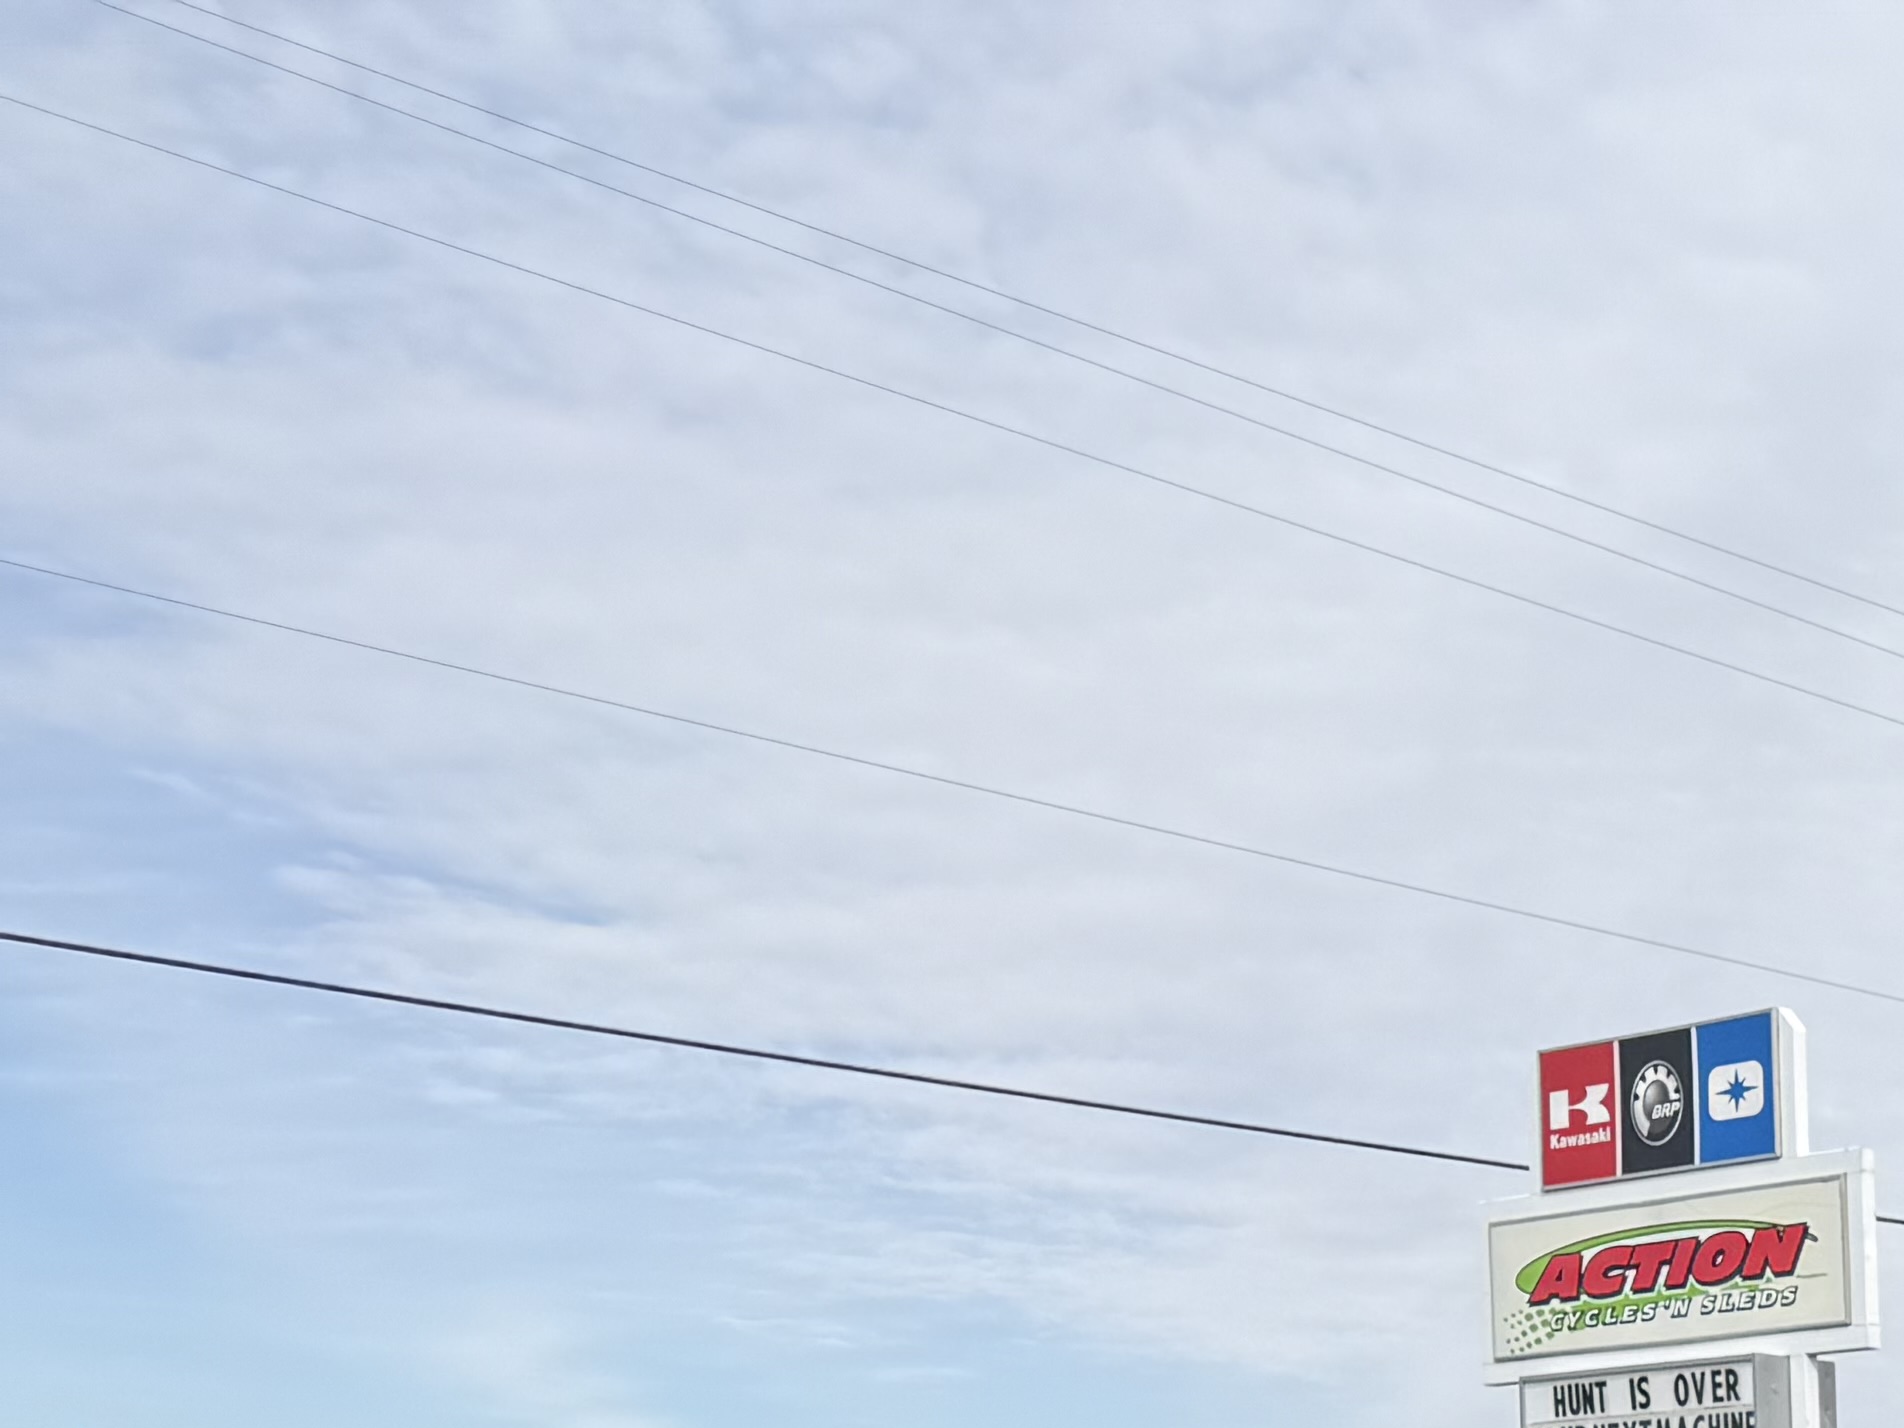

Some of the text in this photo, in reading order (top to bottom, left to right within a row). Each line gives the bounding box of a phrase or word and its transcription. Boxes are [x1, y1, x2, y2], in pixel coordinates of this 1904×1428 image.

[1651, 1101, 1682, 1120] BRP
[1550, 1125, 1611, 1150] Kawasaki
[1527, 1222, 1808, 1307] ACTION
[1700, 1285, 1799, 1313] SLEDS
[1553, 1367, 1741, 1417] HUNT IS OVER
